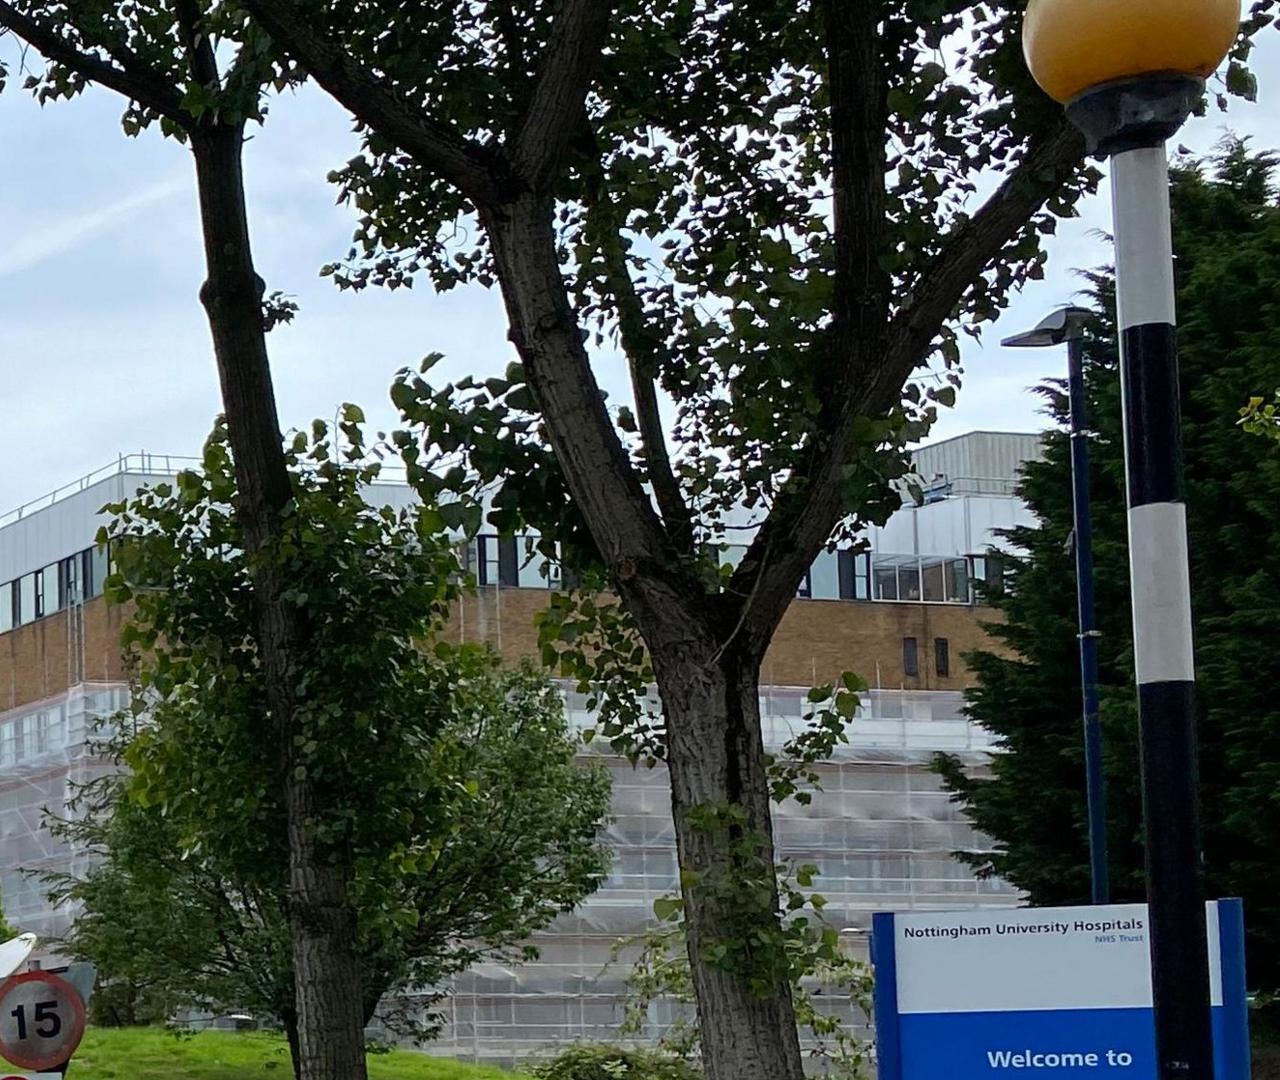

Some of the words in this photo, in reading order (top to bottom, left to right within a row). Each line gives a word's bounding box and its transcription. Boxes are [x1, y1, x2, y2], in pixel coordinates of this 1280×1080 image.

[904, 924, 991, 939] Nottingham
[996, 921, 1069, 935] University
[1074, 919, 1143, 932] Hospitals
[1095, 935, 1116, 943] NHS
[1120, 934, 1143, 943] Trust
[11, 1000, 62, 1040] 15
[987, 1050, 1098, 1068] Welcome
[1106, 1050, 1133, 1067] to
